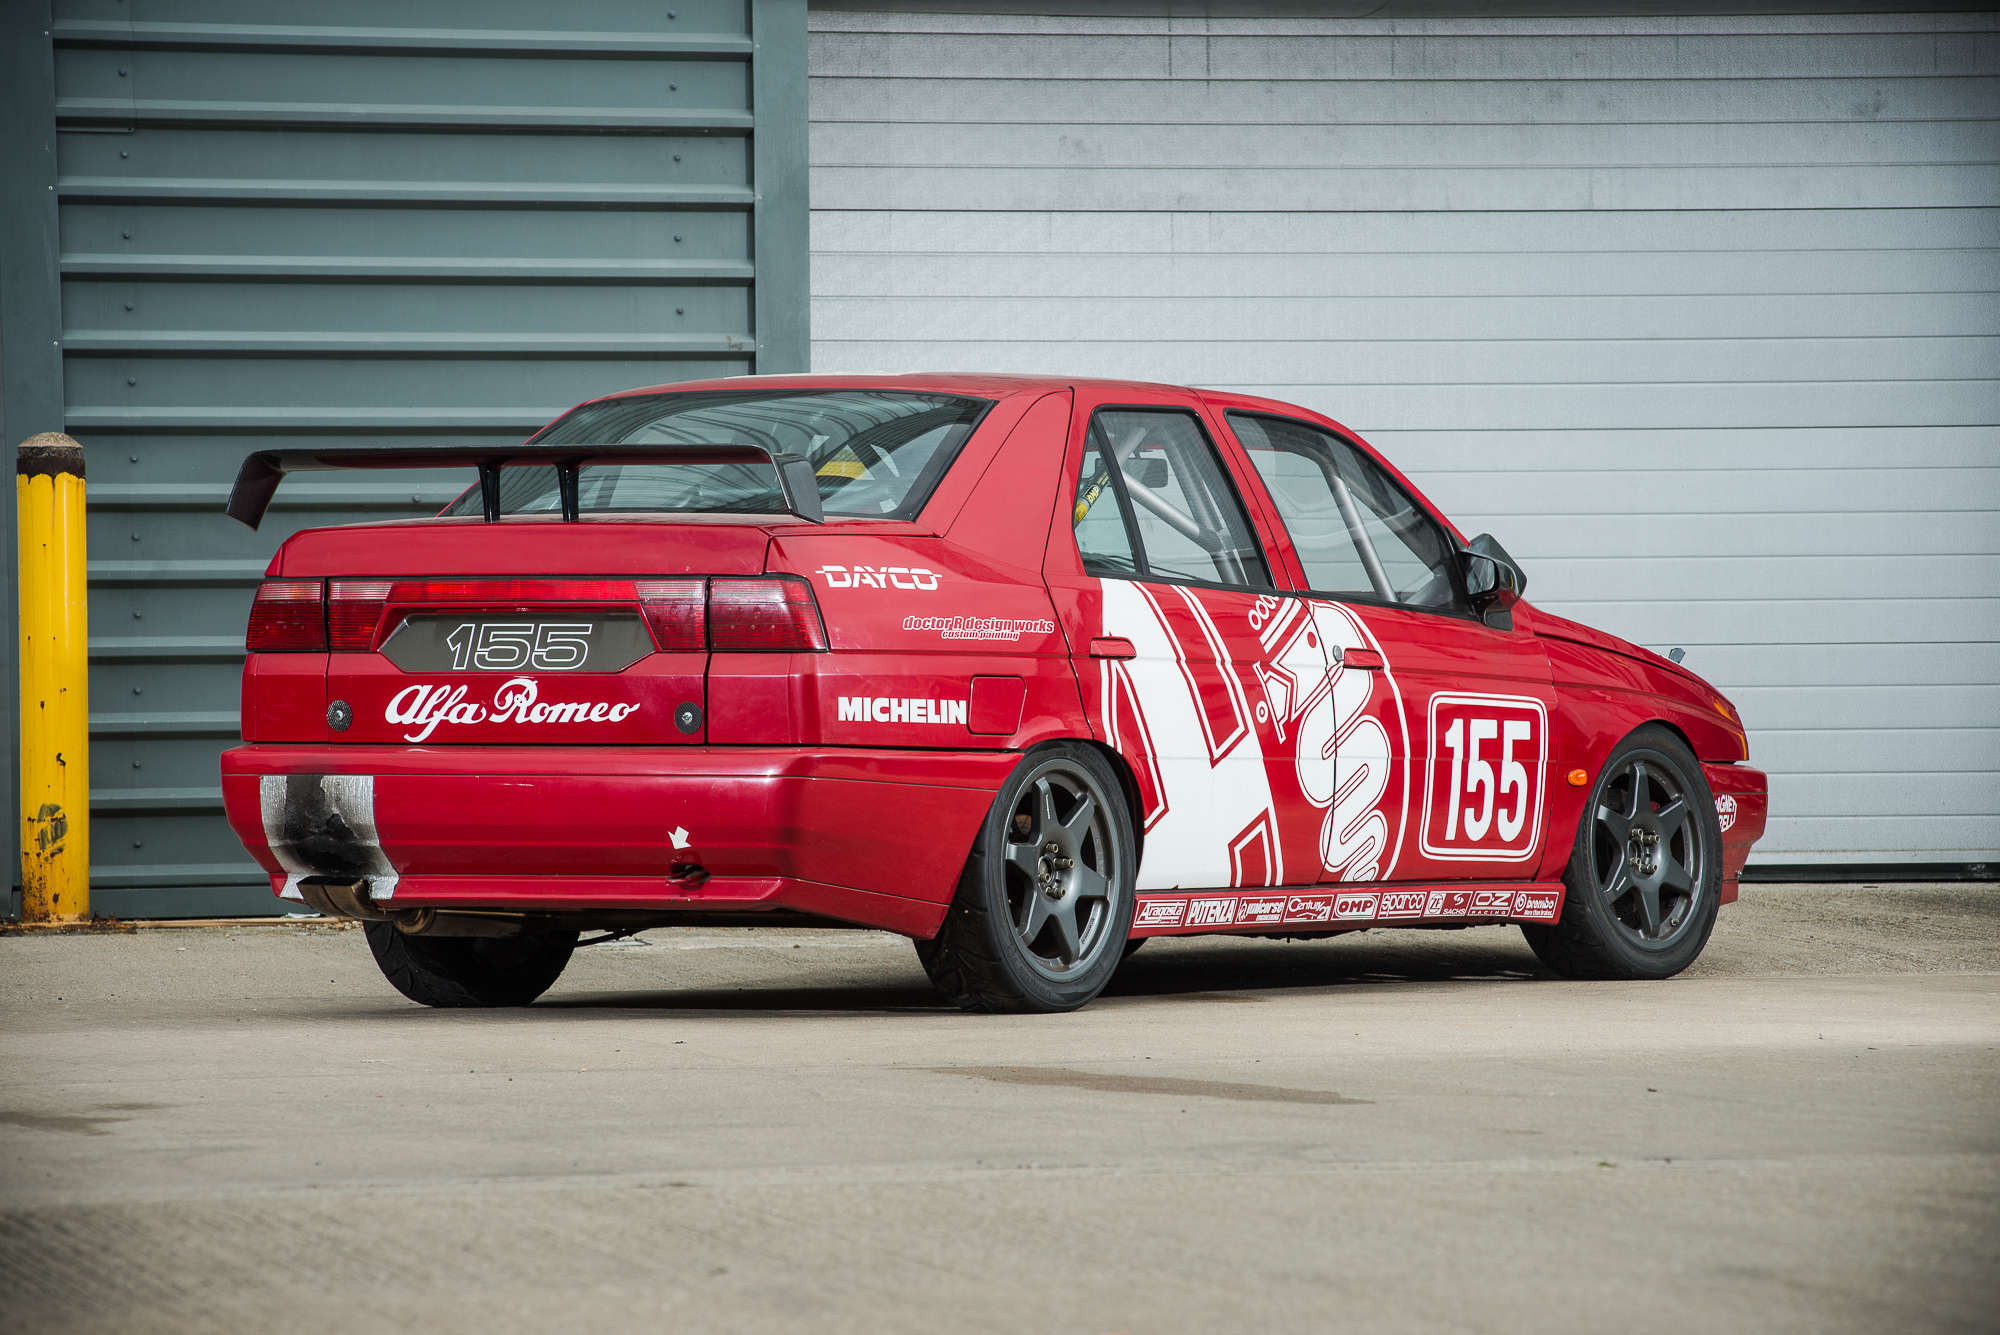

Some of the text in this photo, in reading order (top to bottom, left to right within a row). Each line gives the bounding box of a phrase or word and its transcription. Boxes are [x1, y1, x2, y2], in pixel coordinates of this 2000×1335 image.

[815, 565, 943, 591] DAYCO
[902, 615, 1054, 633] doctor R design works
[941, 630, 1020, 642] custom painting
[446, 623, 593, 670] 155
[384, 678, 641, 743] Alfa Romeo
[837, 696, 967, 725] MICHELIN
[1445, 718, 1531, 842] 155
[1186, 899, 1236, 924] POTENZA
[1288, 897, 1331, 920] Century 21
[1338, 900, 1373, 913] OMP
[1382, 894, 1424, 914] sparco
